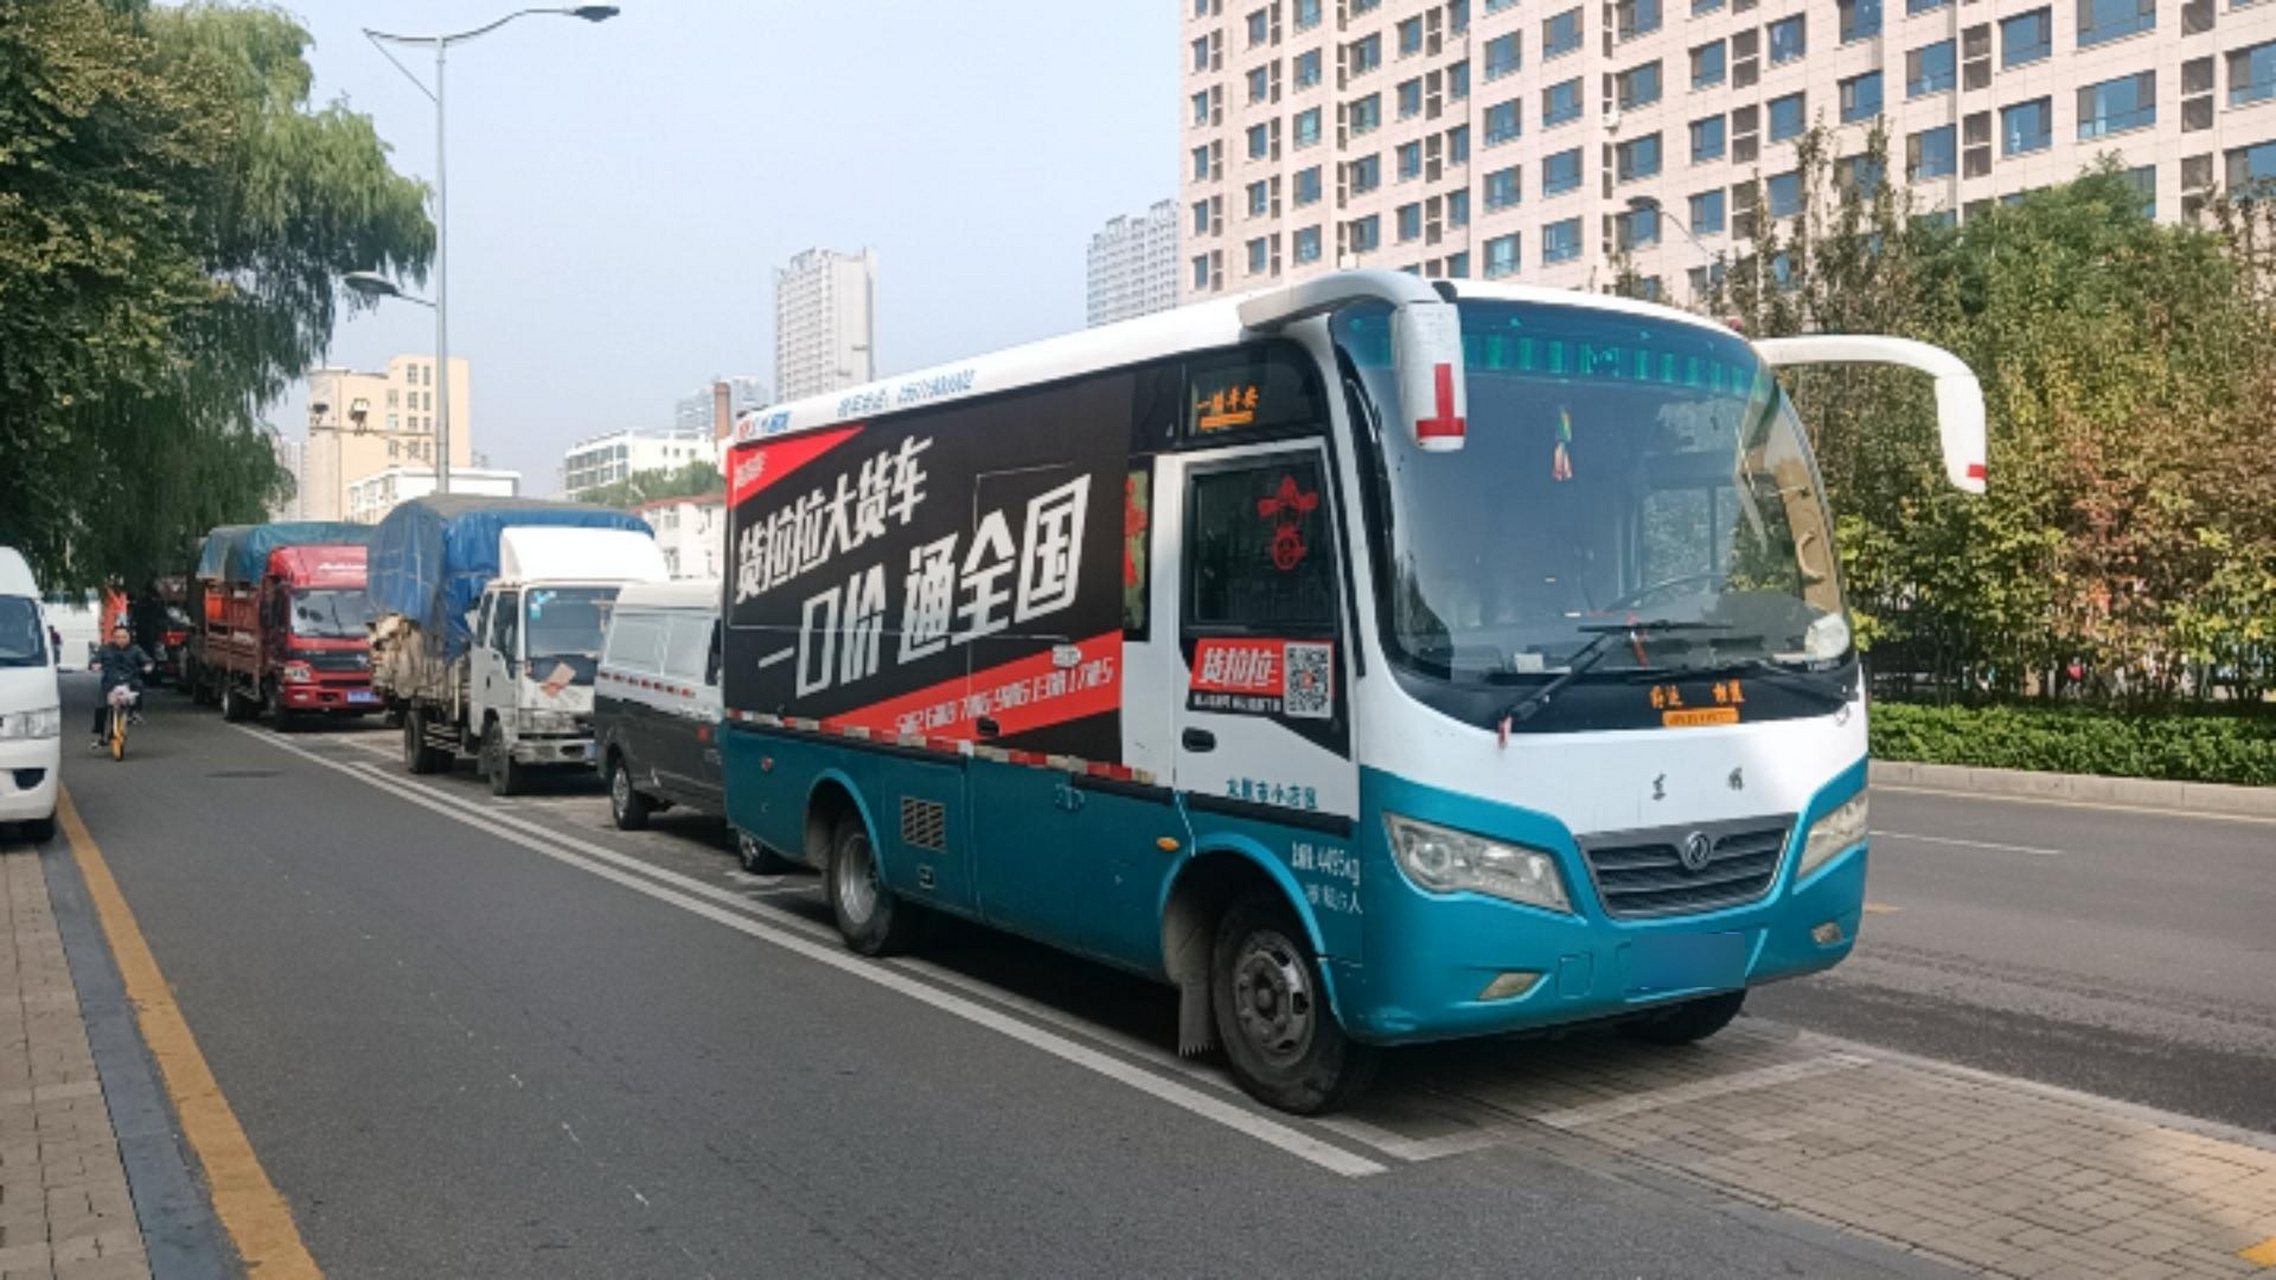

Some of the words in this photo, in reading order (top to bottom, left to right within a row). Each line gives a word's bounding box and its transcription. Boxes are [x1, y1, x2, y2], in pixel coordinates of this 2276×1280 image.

[735, 435, 933, 604] 货拉拉大货车
[758, 564, 887, 699] 一口价
[898, 474, 1091, 664] 通全国
